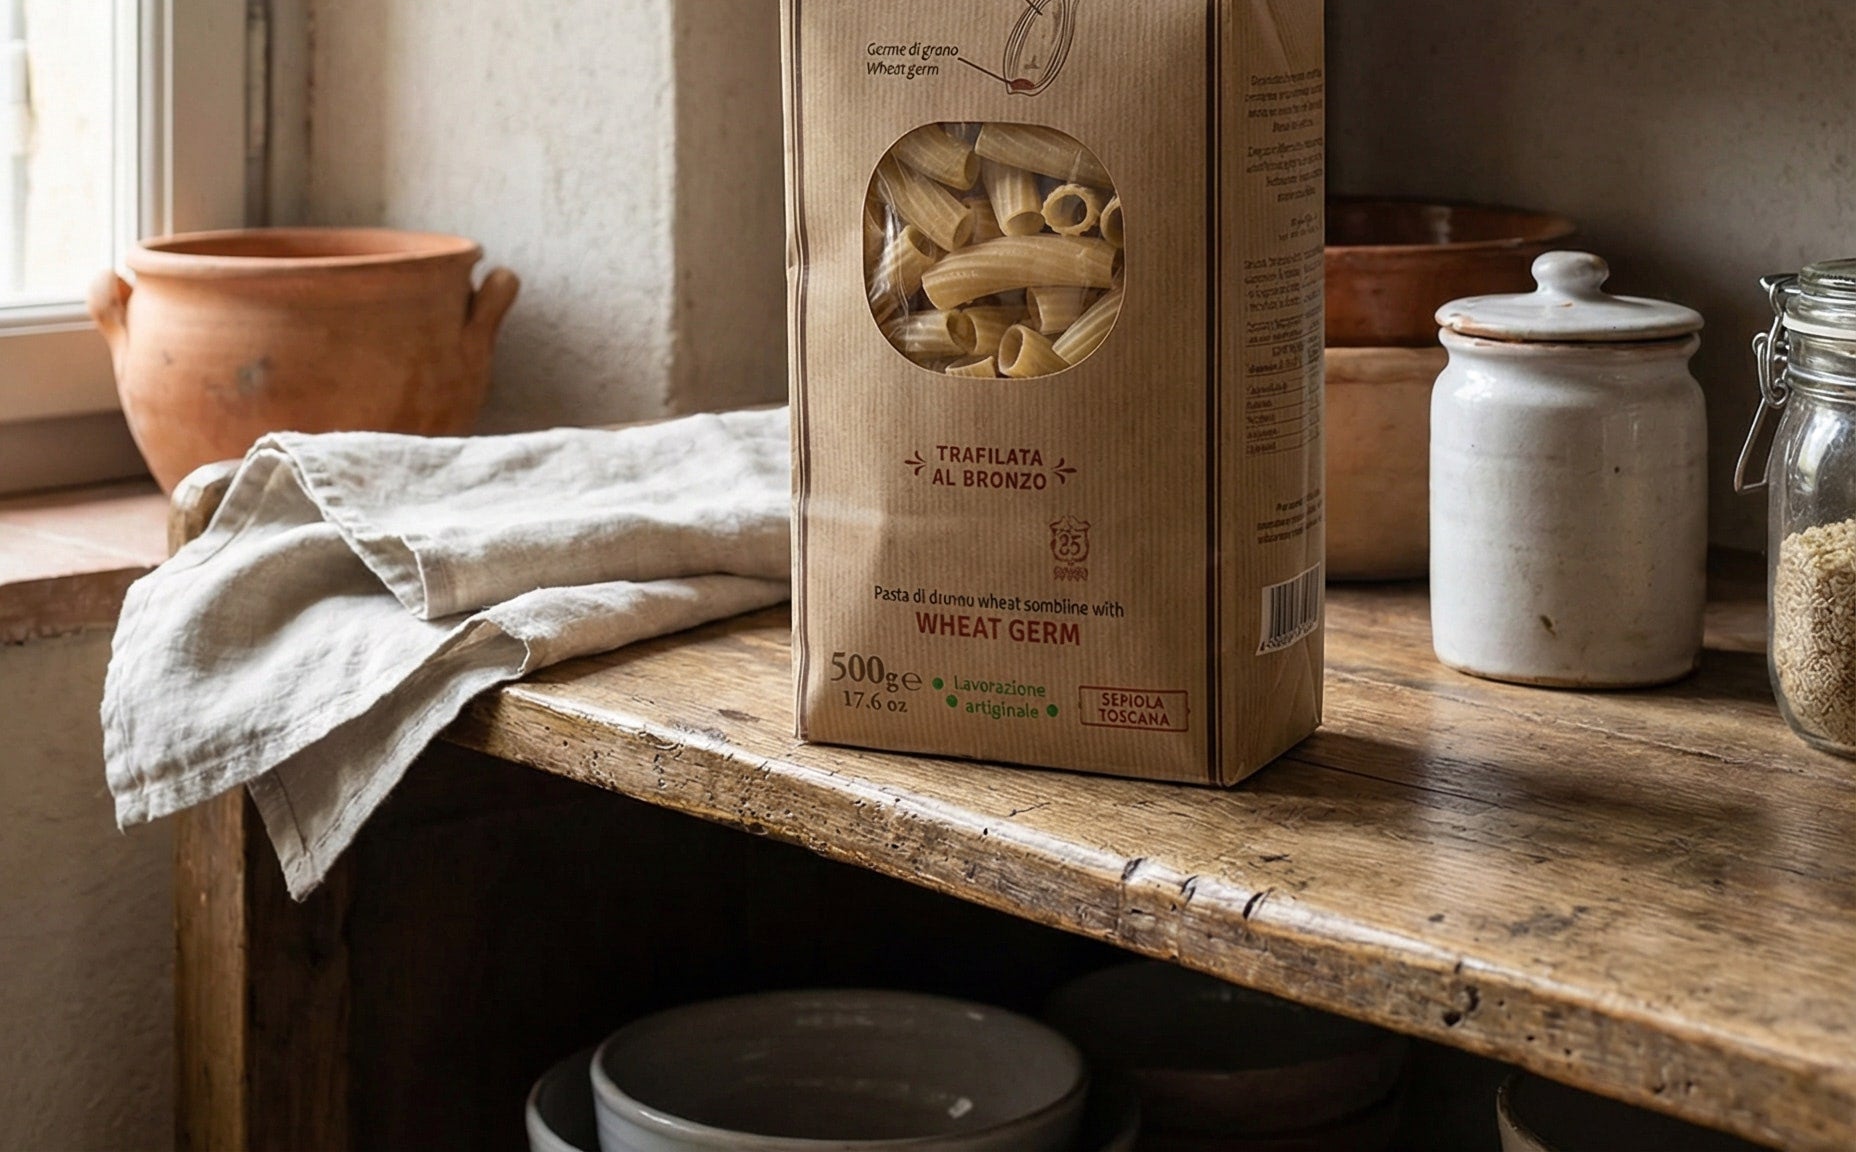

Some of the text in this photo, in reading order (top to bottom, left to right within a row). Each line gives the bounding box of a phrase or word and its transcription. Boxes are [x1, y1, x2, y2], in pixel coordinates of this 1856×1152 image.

[906, 64, 939, 79] germ
[936, 445, 1043, 466] TRAFILATA
[932, 471, 1047, 490] AL BRONZO
[874, 586, 909, 602] Pasta
[1092, 602, 1124, 617] with
[916, 612, 1080, 646] WHEAT GERM
[843, 690, 907, 713] 17.6 oz
[966, 701, 1039, 719] artiginale
[1102, 693, 1164, 709] SEPIOLA
[1098, 709, 1170, 726] TOSCANA
